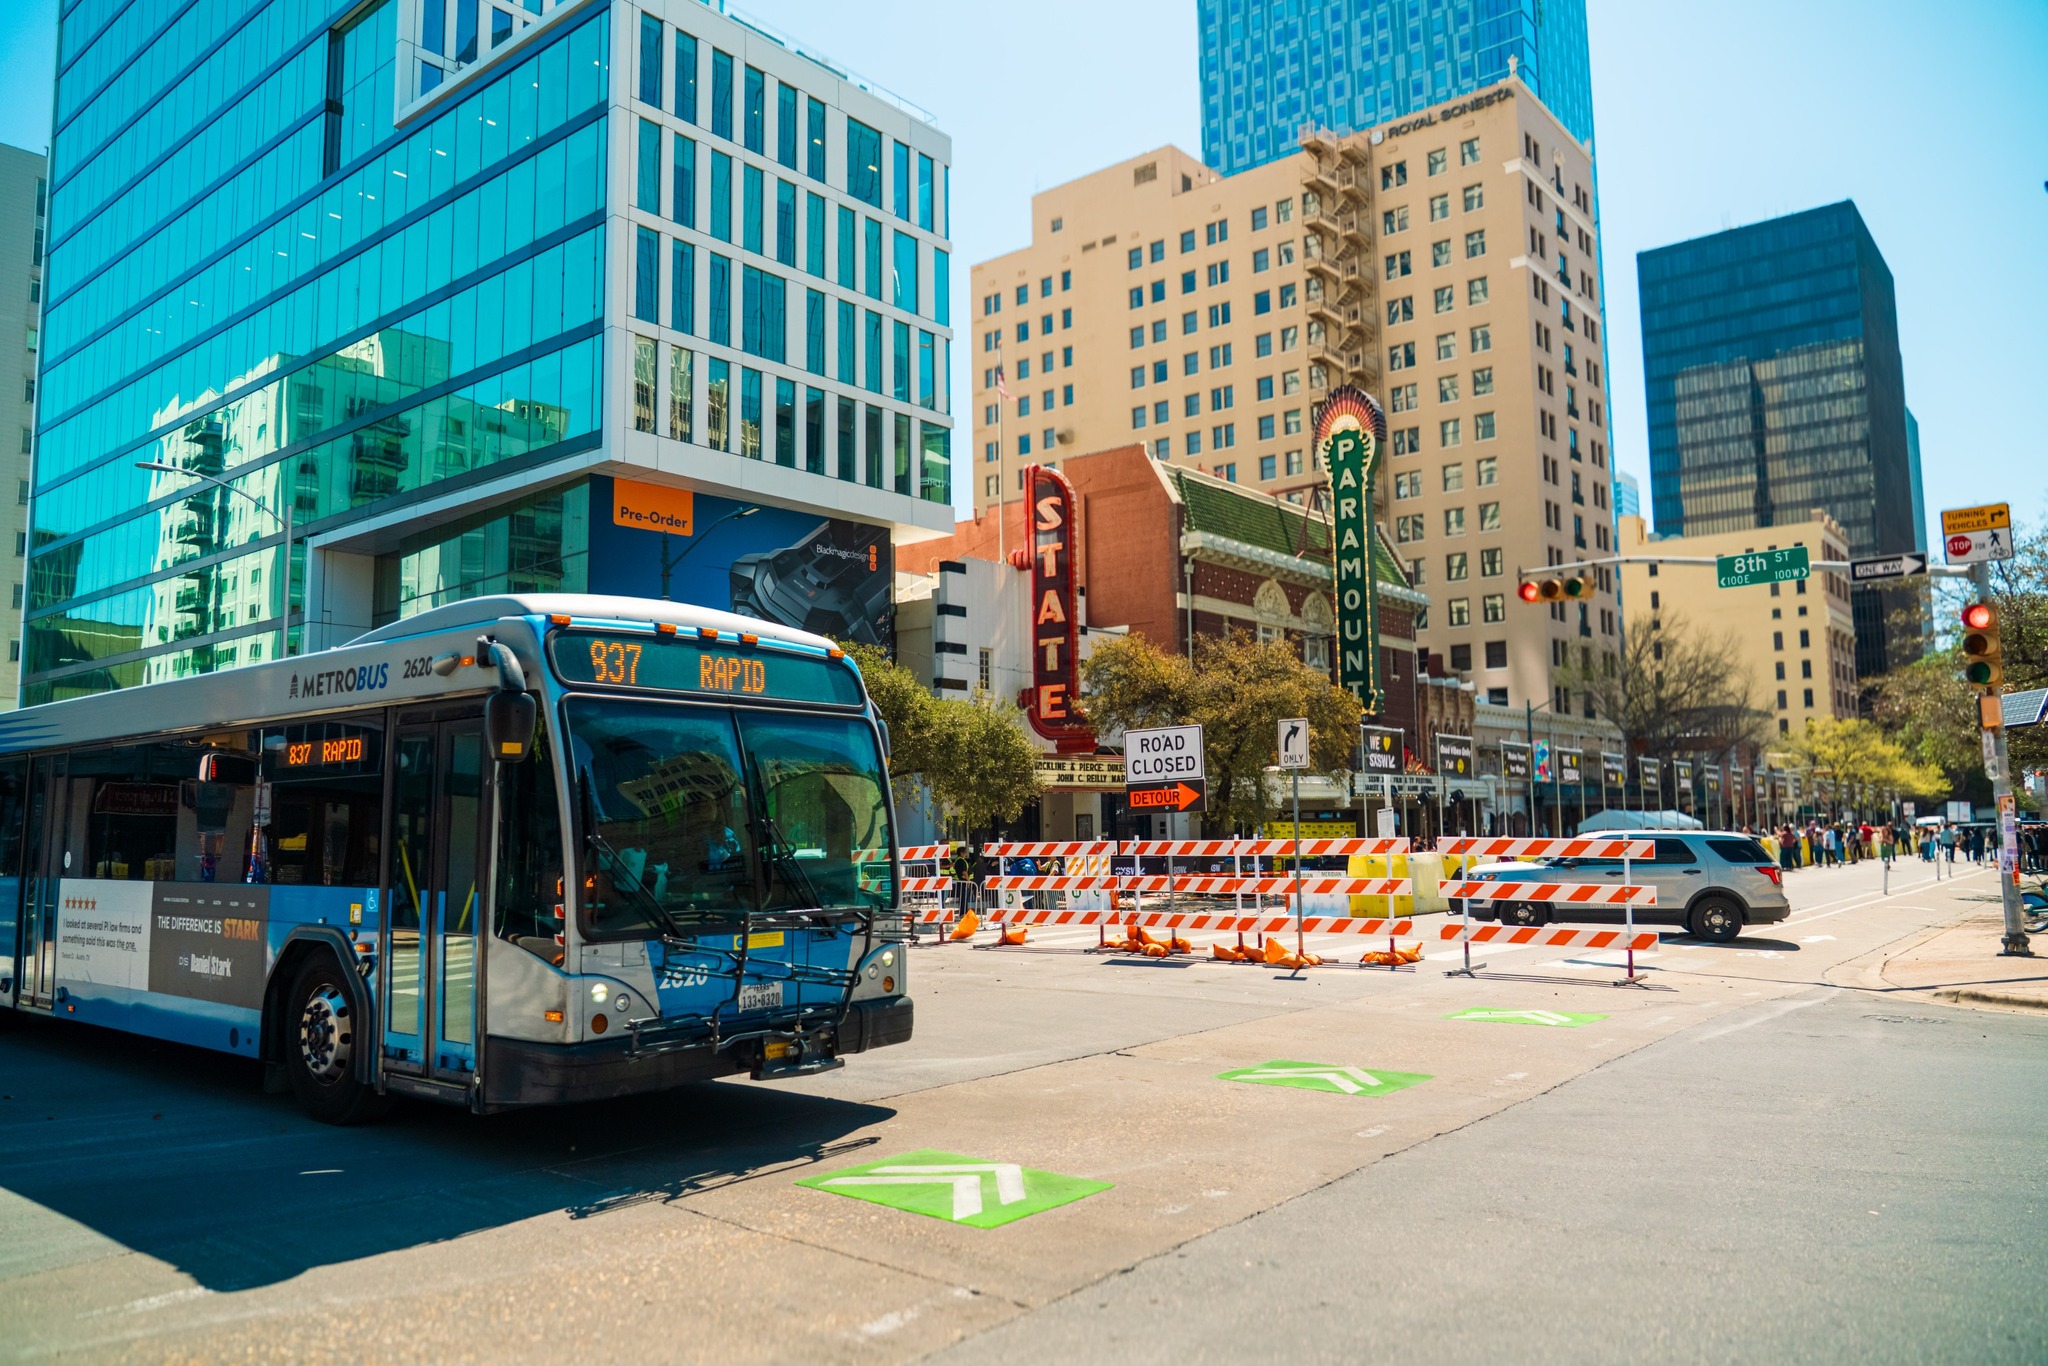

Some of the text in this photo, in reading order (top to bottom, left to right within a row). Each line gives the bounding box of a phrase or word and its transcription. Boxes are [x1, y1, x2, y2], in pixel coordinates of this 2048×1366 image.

[1389, 88, 1514, 139] ROYAL SONESTA
[620, 506, 688, 529] Pre-Order
[1947, 509, 1986, 520] TURNING
[1947, 519, 1988, 531] VEHICLES
[1948, 541, 1971, 552] STOP
[1975, 542, 1985, 550] FOR
[1337, 438, 1364, 699] PARAMOUNT
[1734, 551, 1790, 574] 8th ST
[1858, 561, 1903, 576] ONE WAY
[1727, 574, 1750, 586] 100E
[1775, 567, 1799, 580] 100W
[1036, 496, 1066, 718] STATE
[403, 656, 433, 679] 2620
[590, 640, 765, 693] 837 RAPID
[302, 662, 389, 698] METROBUS
[1141, 735, 1185, 753] ROAD
[1369, 735, 1380, 750] WE
[289, 739, 362, 765] 837 RAPID
[1283, 754, 1304, 765] ONLY
[1369, 754, 1389, 768] SXSW
[1132, 755, 1196, 775] CLOSED
[1056, 774, 1074, 782] JOHN
[1086, 774, 1107, 783] REILLY
[1133, 791, 1180, 805] DETOUR
[157, 916, 260, 941] THE DIFFERENCE IS STARK
[190, 953, 232, 978] Daniel Stark
